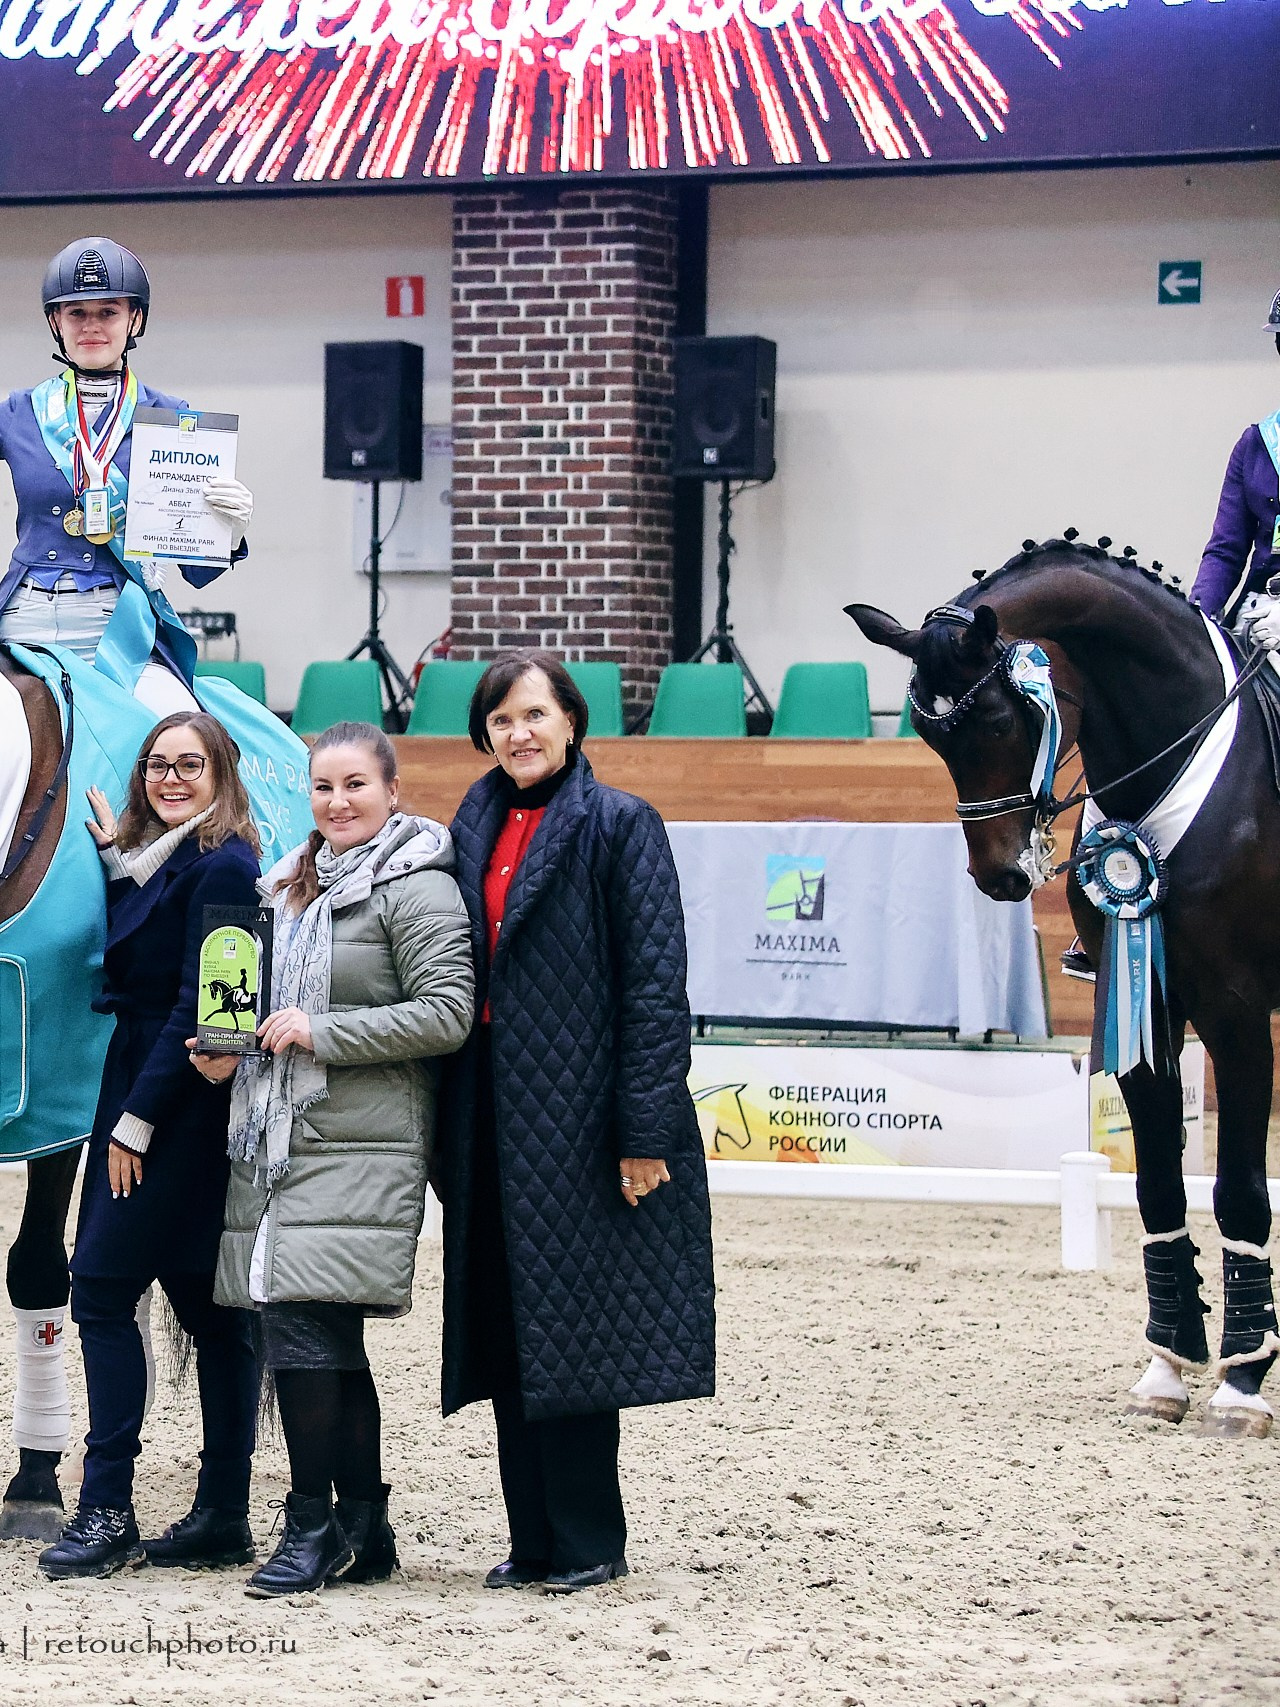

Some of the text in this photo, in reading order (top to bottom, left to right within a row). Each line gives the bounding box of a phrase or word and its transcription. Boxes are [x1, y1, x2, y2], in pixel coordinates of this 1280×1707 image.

[149, 449, 220, 467] ДИПЛОМ
[149, 471, 218, 484] НАГРАЖДАЕТС
[168, 500, 192, 508] АББАТ
[142, 534, 215, 546] ФИНАЛ MAXIMA PARK
[169, 544, 200, 553] ВЫЕЗДКЕ
[754, 933, 841, 953] MAXIMA
[205, 1032, 233, 1040] ГРАН-ПРИ
[208, 1038, 244, 1046] ПОБЕДИТЕЛЬ
[769, 1085, 886, 1105] ФЕДЕРАЦИЯ
[769, 1110, 943, 1130] КОННОГО СПОРТА
[769, 1135, 846, 1153] РОССИИ
